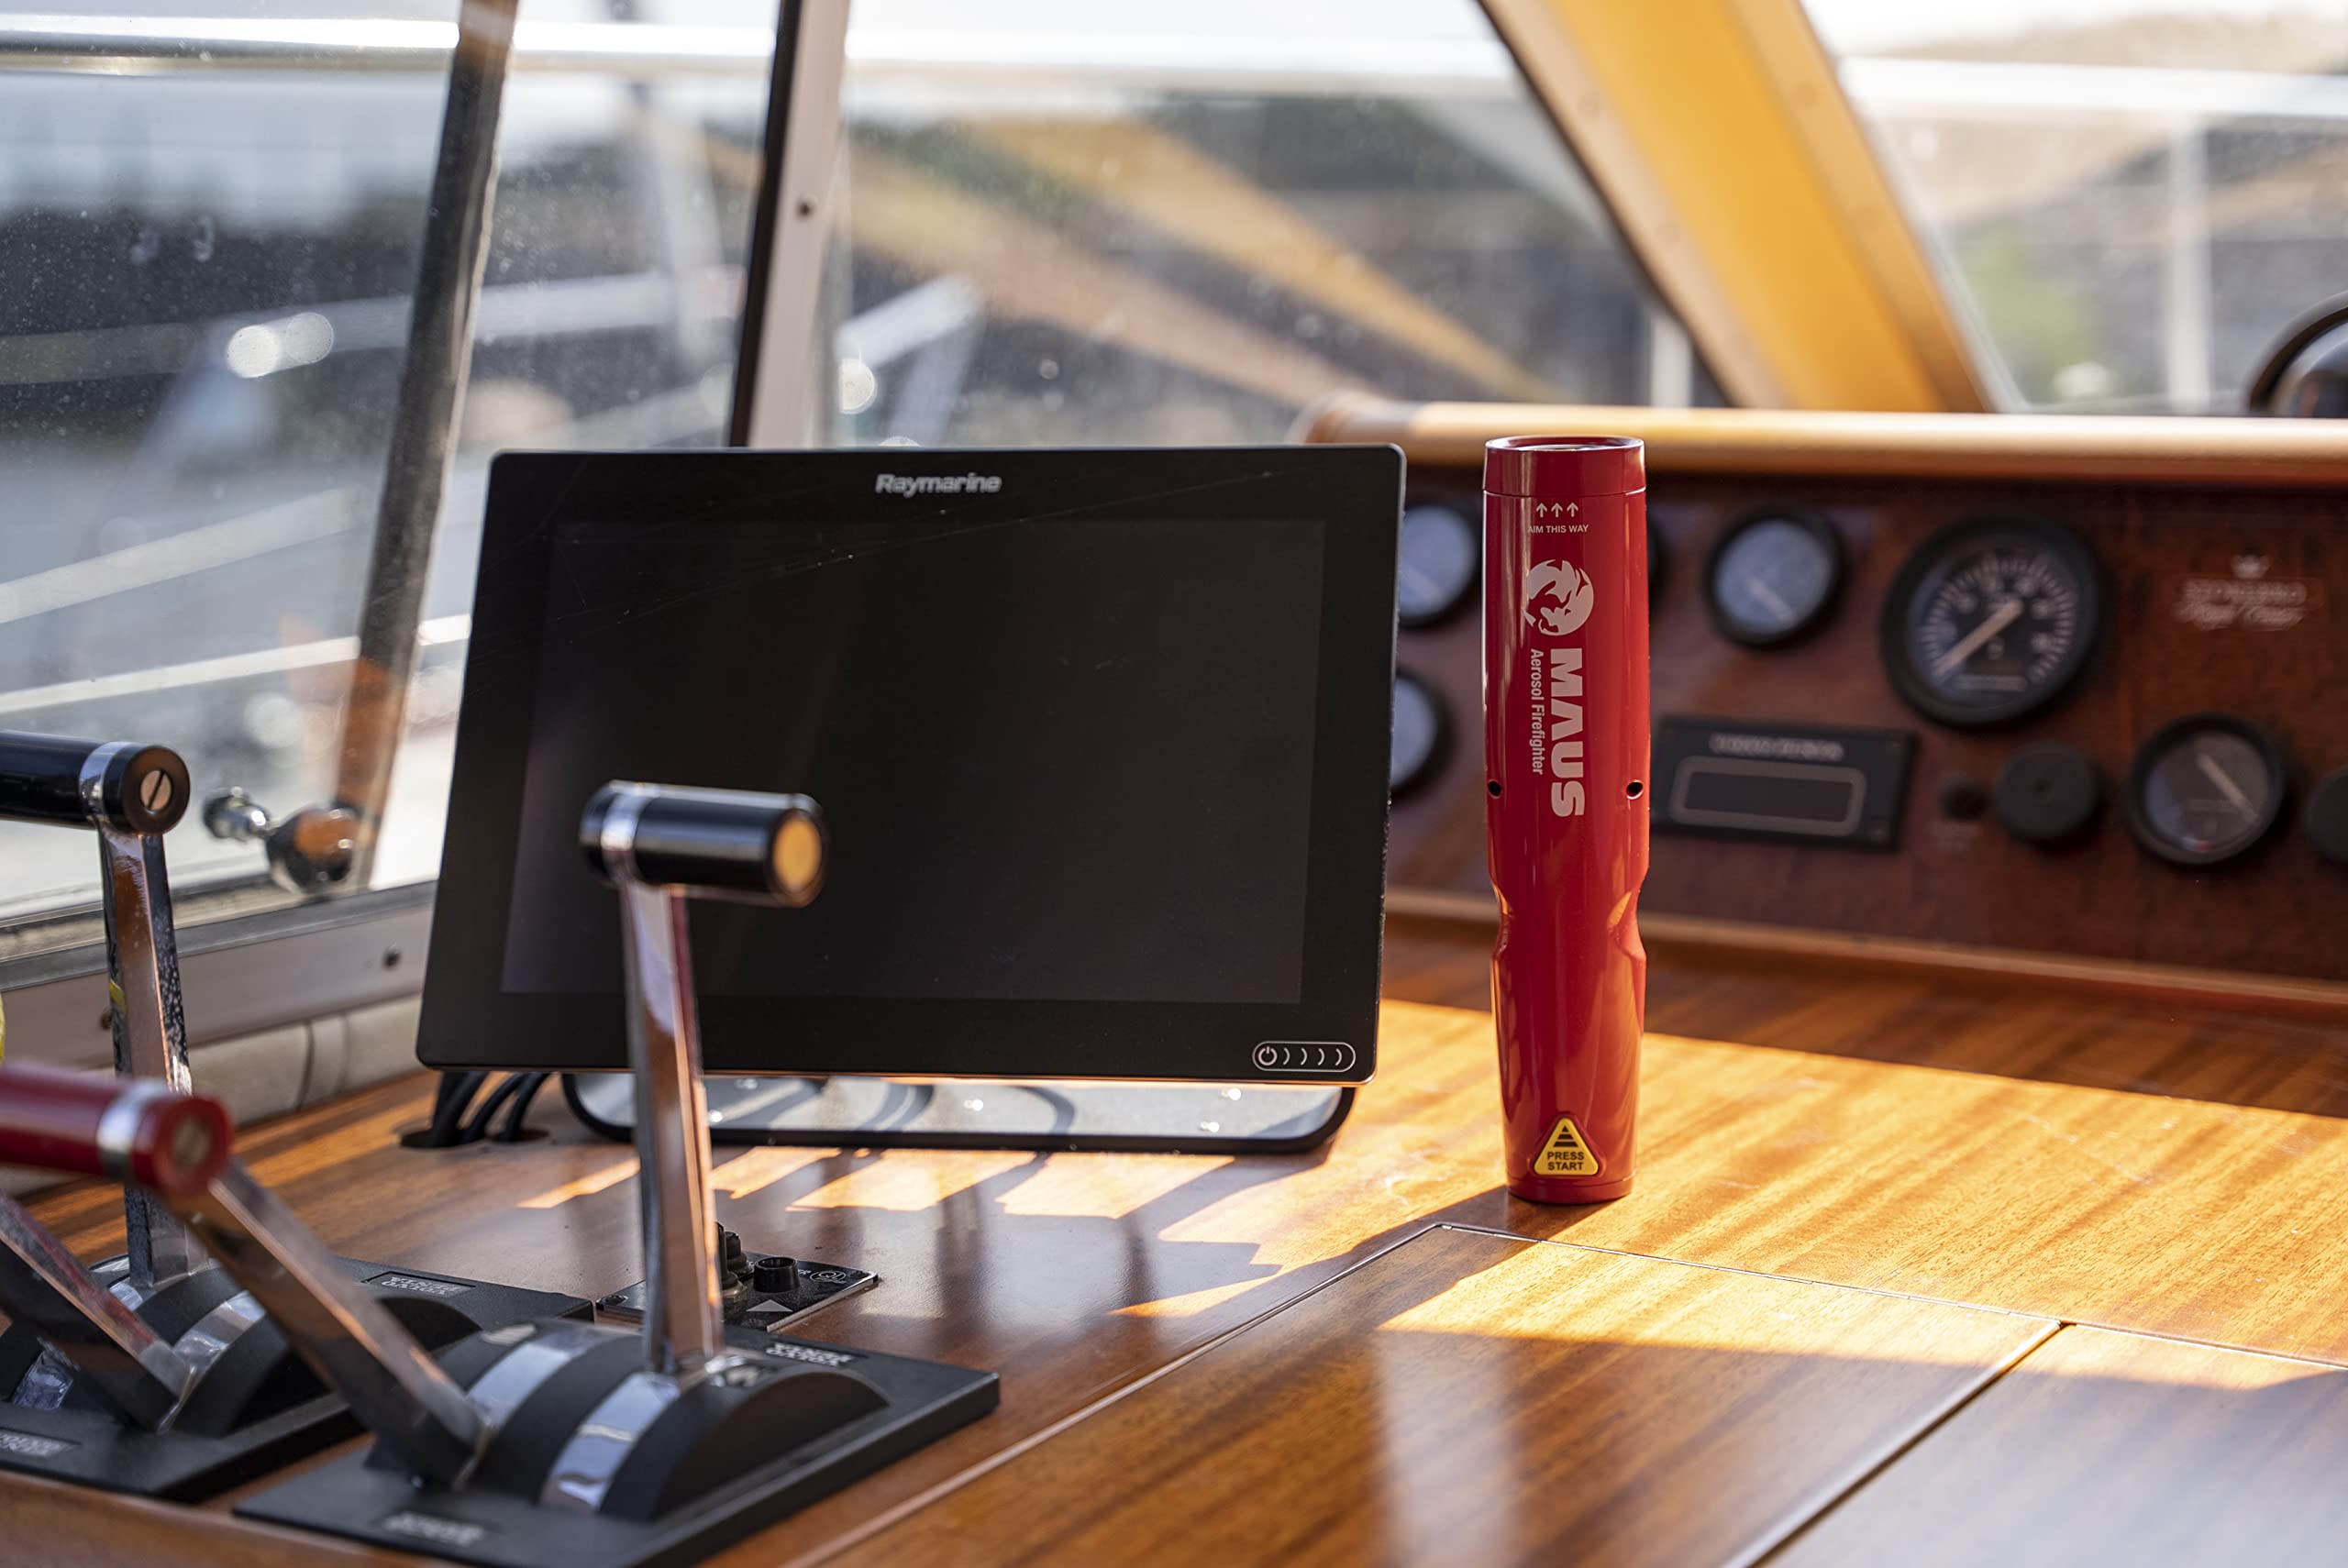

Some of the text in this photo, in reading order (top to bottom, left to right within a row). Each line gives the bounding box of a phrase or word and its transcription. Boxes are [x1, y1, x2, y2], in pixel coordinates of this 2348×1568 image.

[875, 472, 1002, 498] Raymarine
[1528, 524, 1589, 534] AIM THIS WAY
[1529, 648, 1545, 775] Aerosol Firefighter
[1550, 647, 1585, 817] MAUS
[1547, 1152, 1585, 1170] PRESS START
